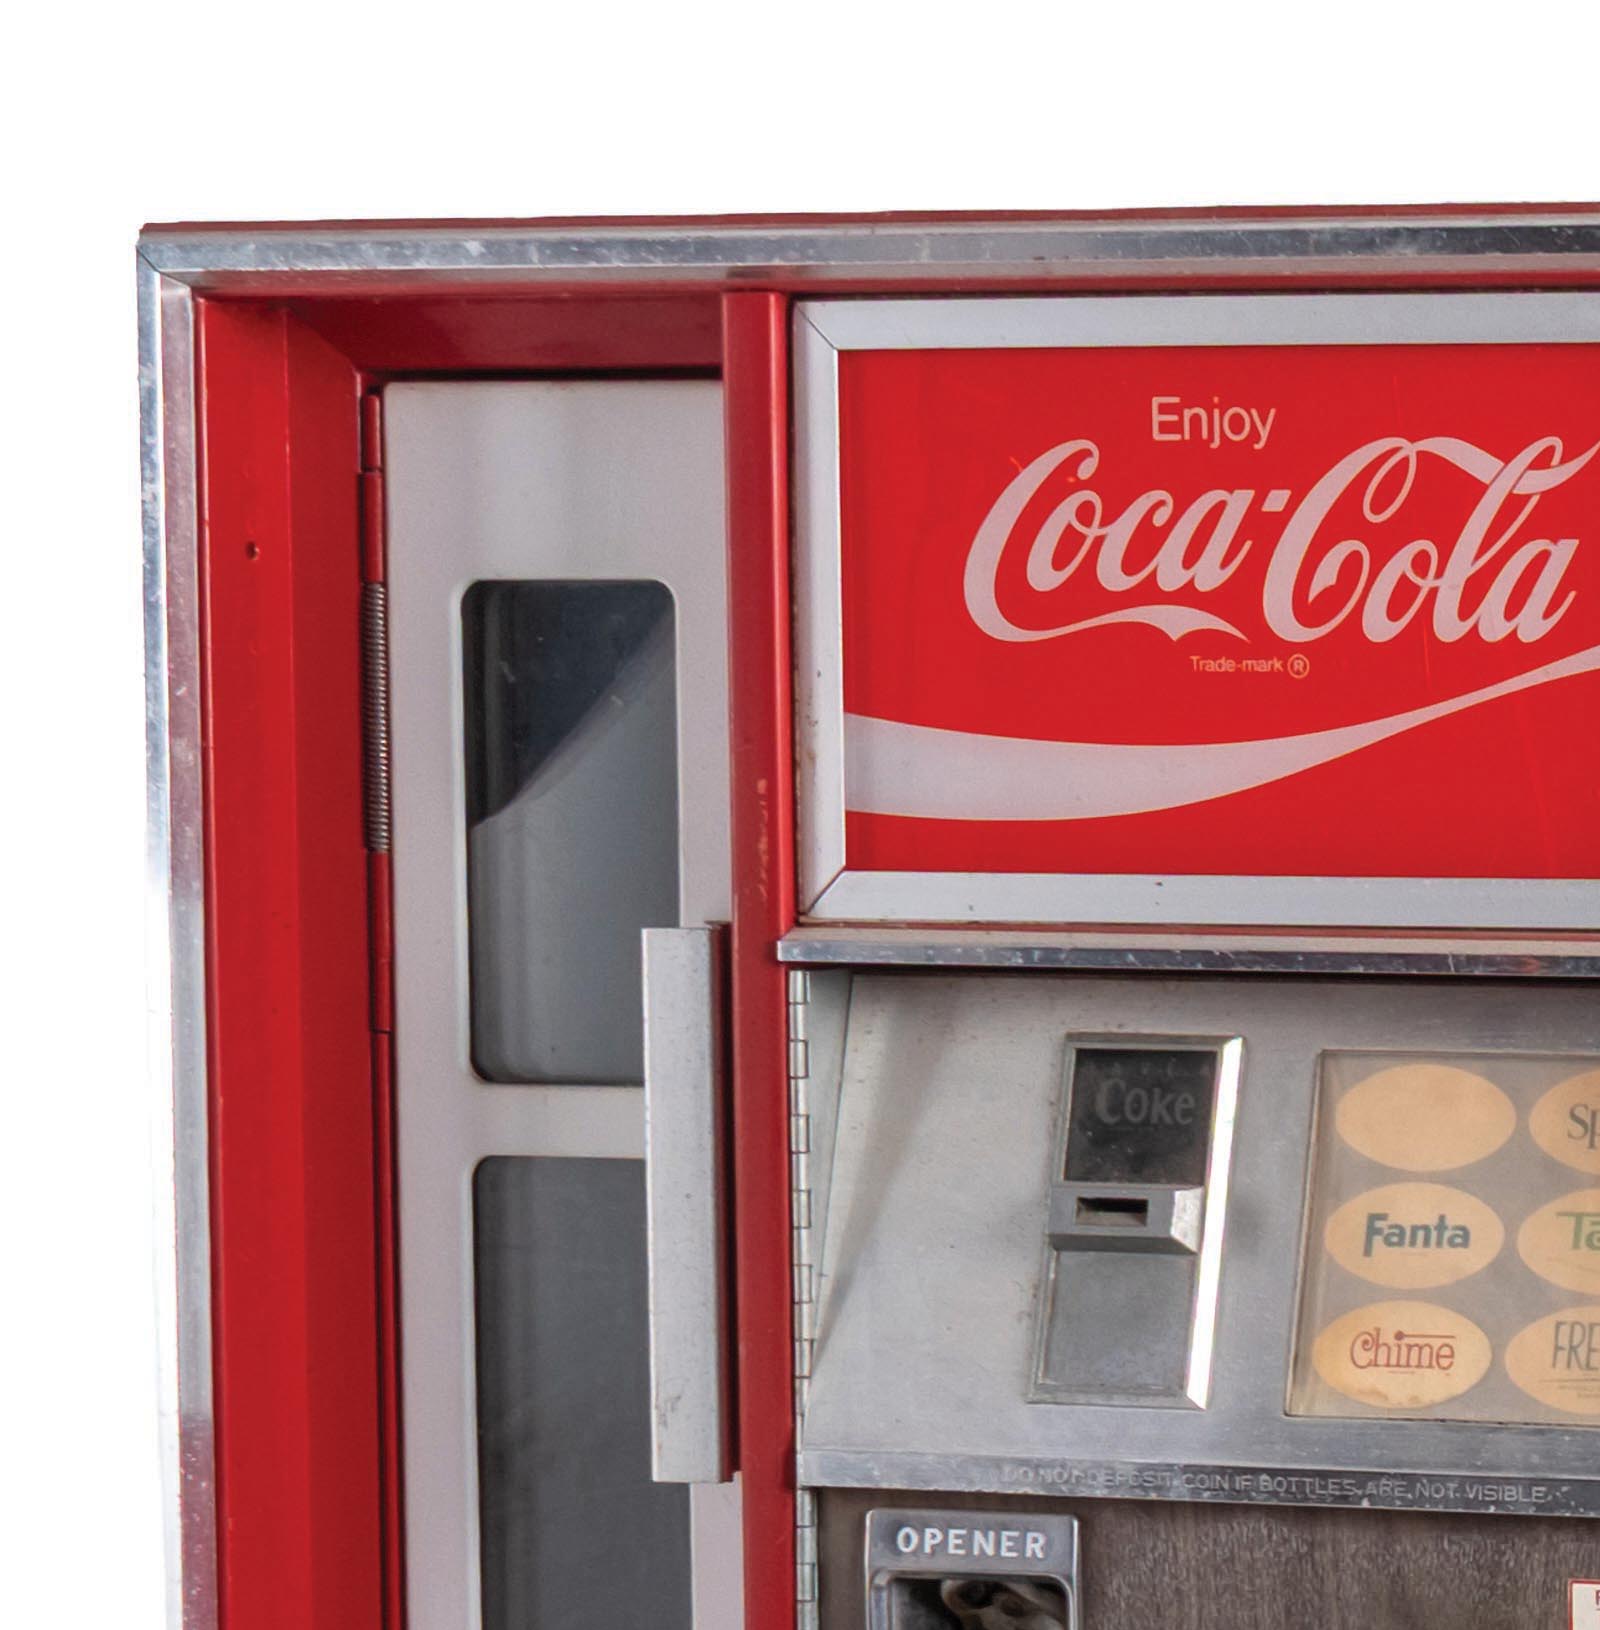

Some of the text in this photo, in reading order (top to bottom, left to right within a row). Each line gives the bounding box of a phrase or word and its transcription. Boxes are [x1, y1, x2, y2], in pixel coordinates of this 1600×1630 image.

[1151, 396, 1277, 449] Enjoy
[1189, 655, 1285, 673] Trade-mark
[1095, 1077, 1197, 1126] Coke
[1362, 1212, 1472, 1258] Fanta
[1349, 1327, 1457, 1371] Chime
[1088, 1470, 1173, 1488] DEPOSIT
[1182, 1473, 1230, 1490] COIN
[1235, 1474, 1252, 1491] IF
[1259, 1474, 1356, 1496] BOTTLES
[896, 1526, 1048, 1559] OPENER
